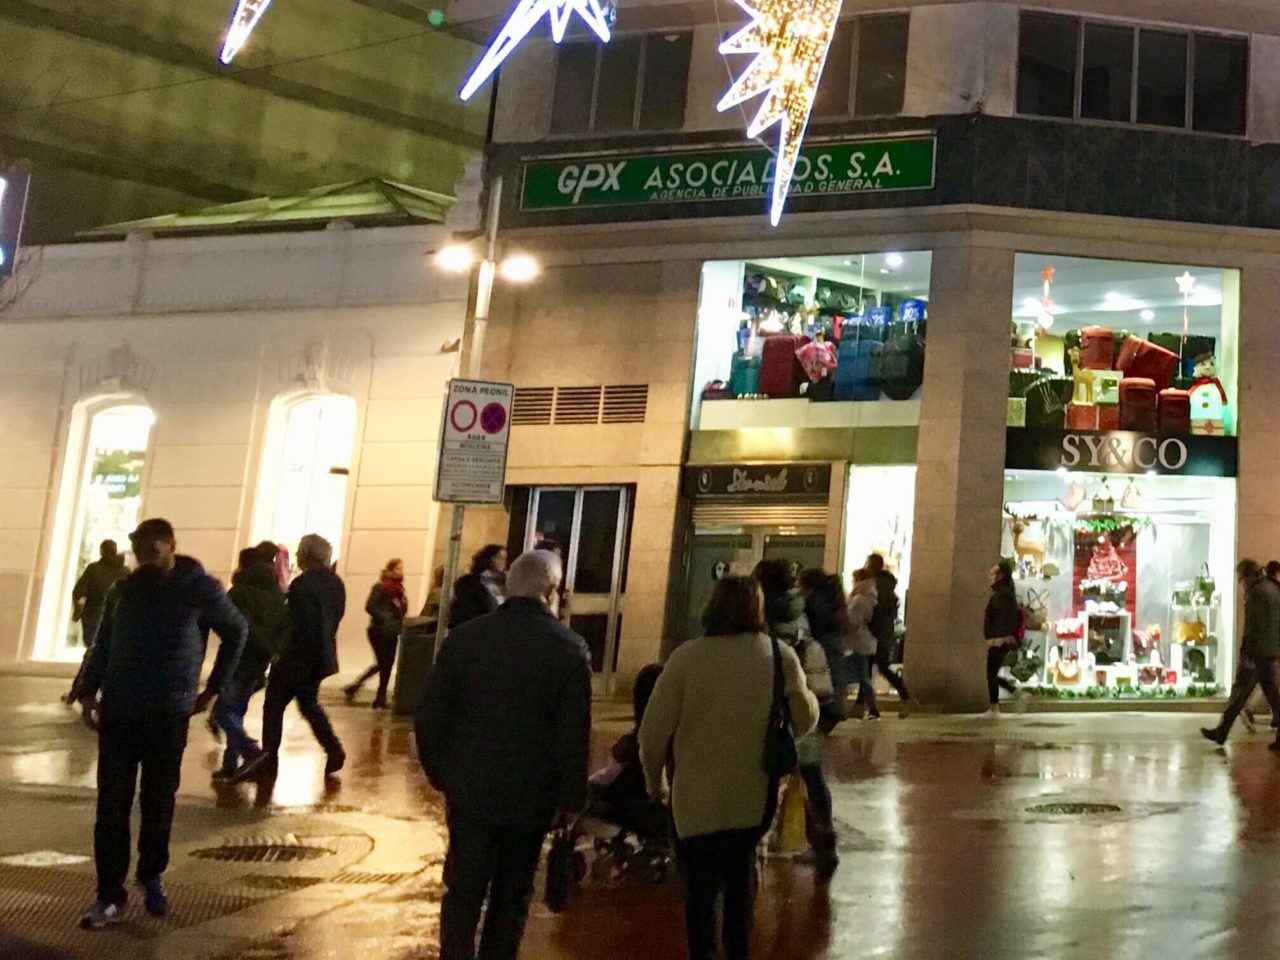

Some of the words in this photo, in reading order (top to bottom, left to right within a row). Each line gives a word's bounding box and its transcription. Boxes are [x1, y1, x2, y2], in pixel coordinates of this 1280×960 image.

[558, 161, 627, 204] GPX
[847, 151, 900, 178] S.A.
[649, 187, 706, 200] AGENCIA
[712, 186, 729, 198] DE
[732, 182, 814, 197] PUBLIAD
[818, 178, 882, 192] GENERAL
[453, 384, 477, 394] ZONA
[1061, 434, 1187, 469] SY&CO
